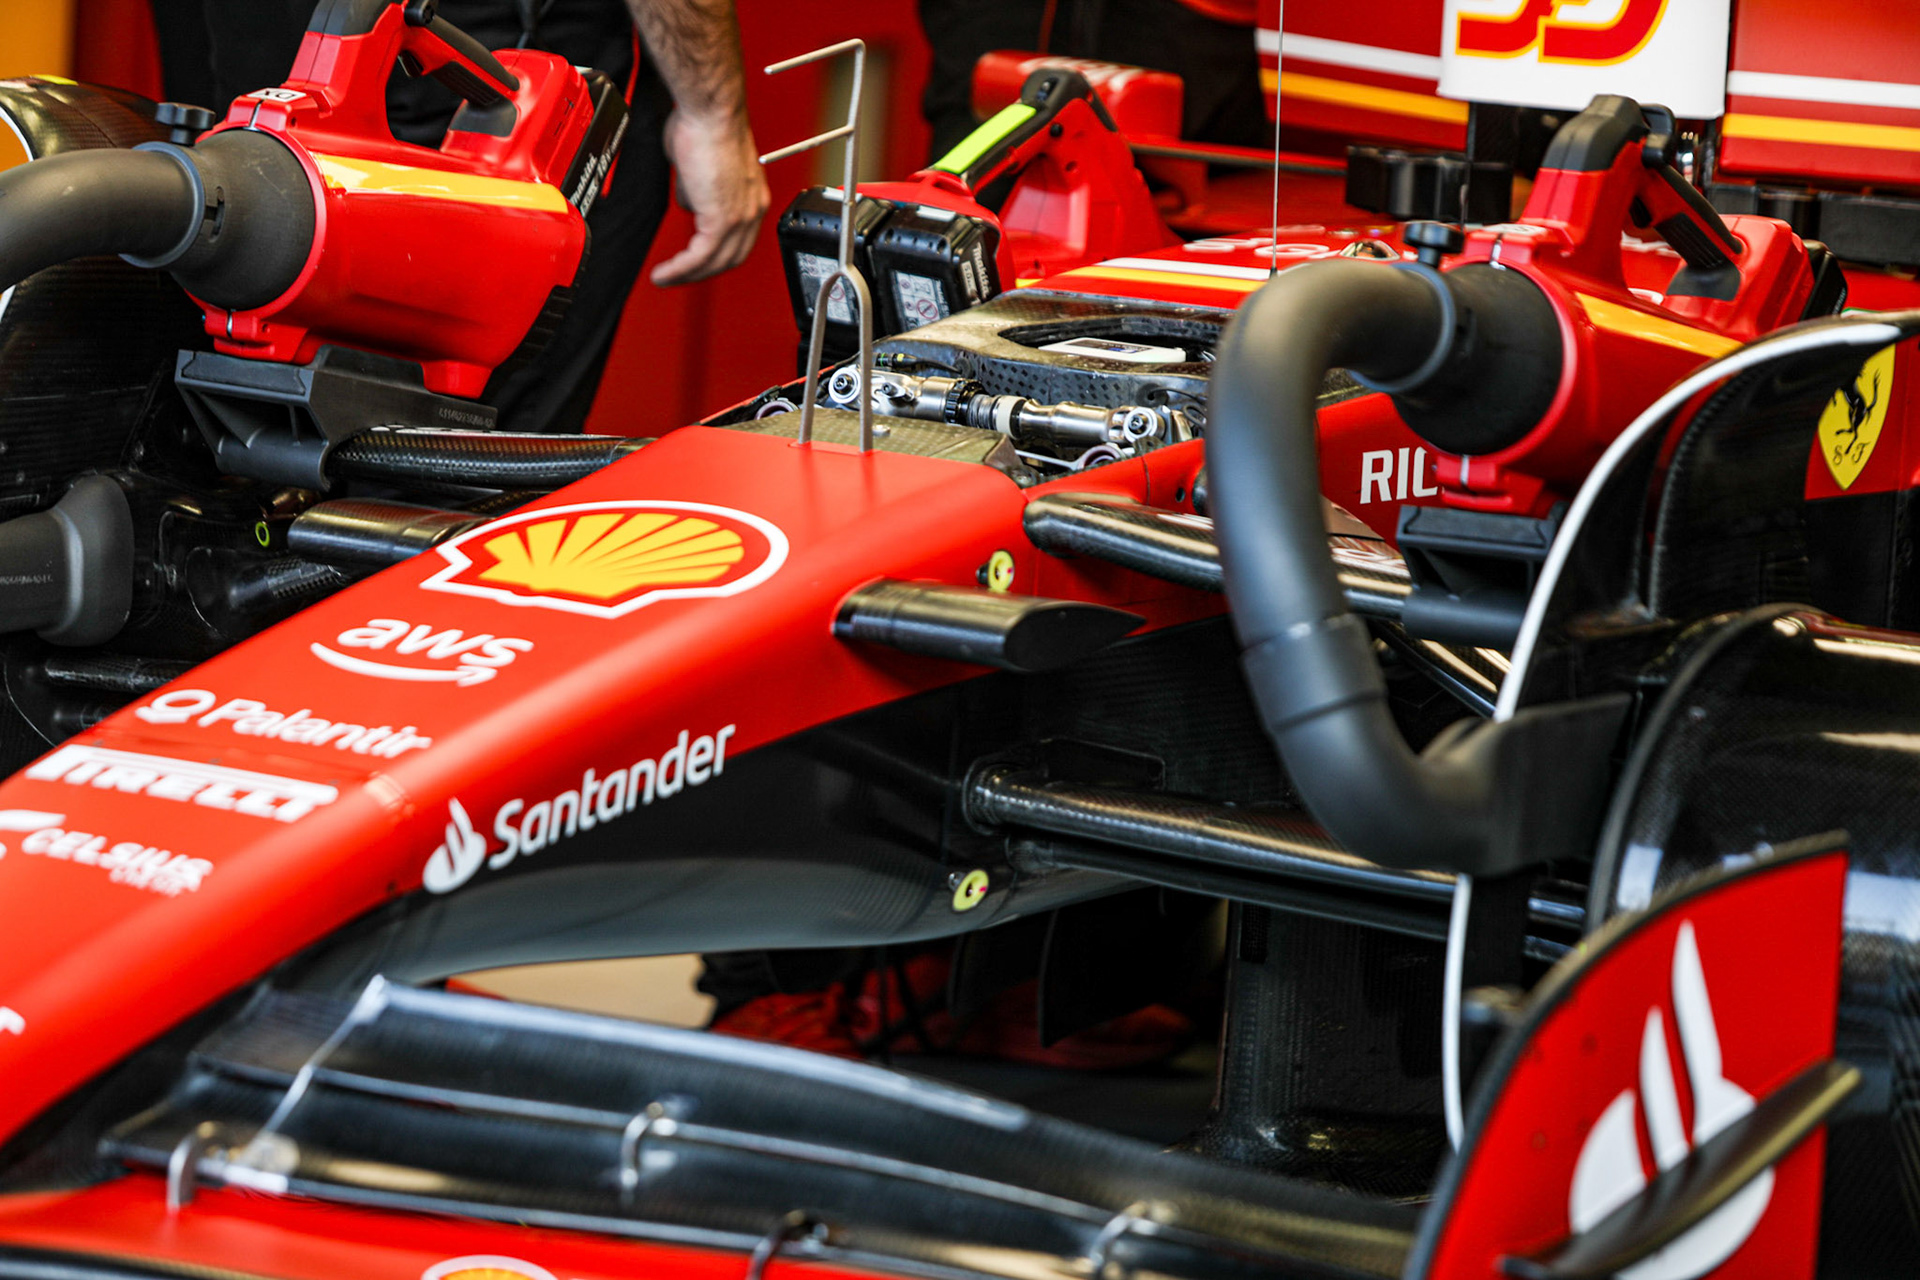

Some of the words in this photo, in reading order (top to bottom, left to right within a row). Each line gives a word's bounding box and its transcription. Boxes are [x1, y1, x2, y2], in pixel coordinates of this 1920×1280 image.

[1359, 446, 1444, 505] RIC
[337, 618, 535, 667] aws
[196, 697, 433, 758] Palantir
[25, 743, 339, 824] PIRELLI
[487, 723, 737, 871] Santander
